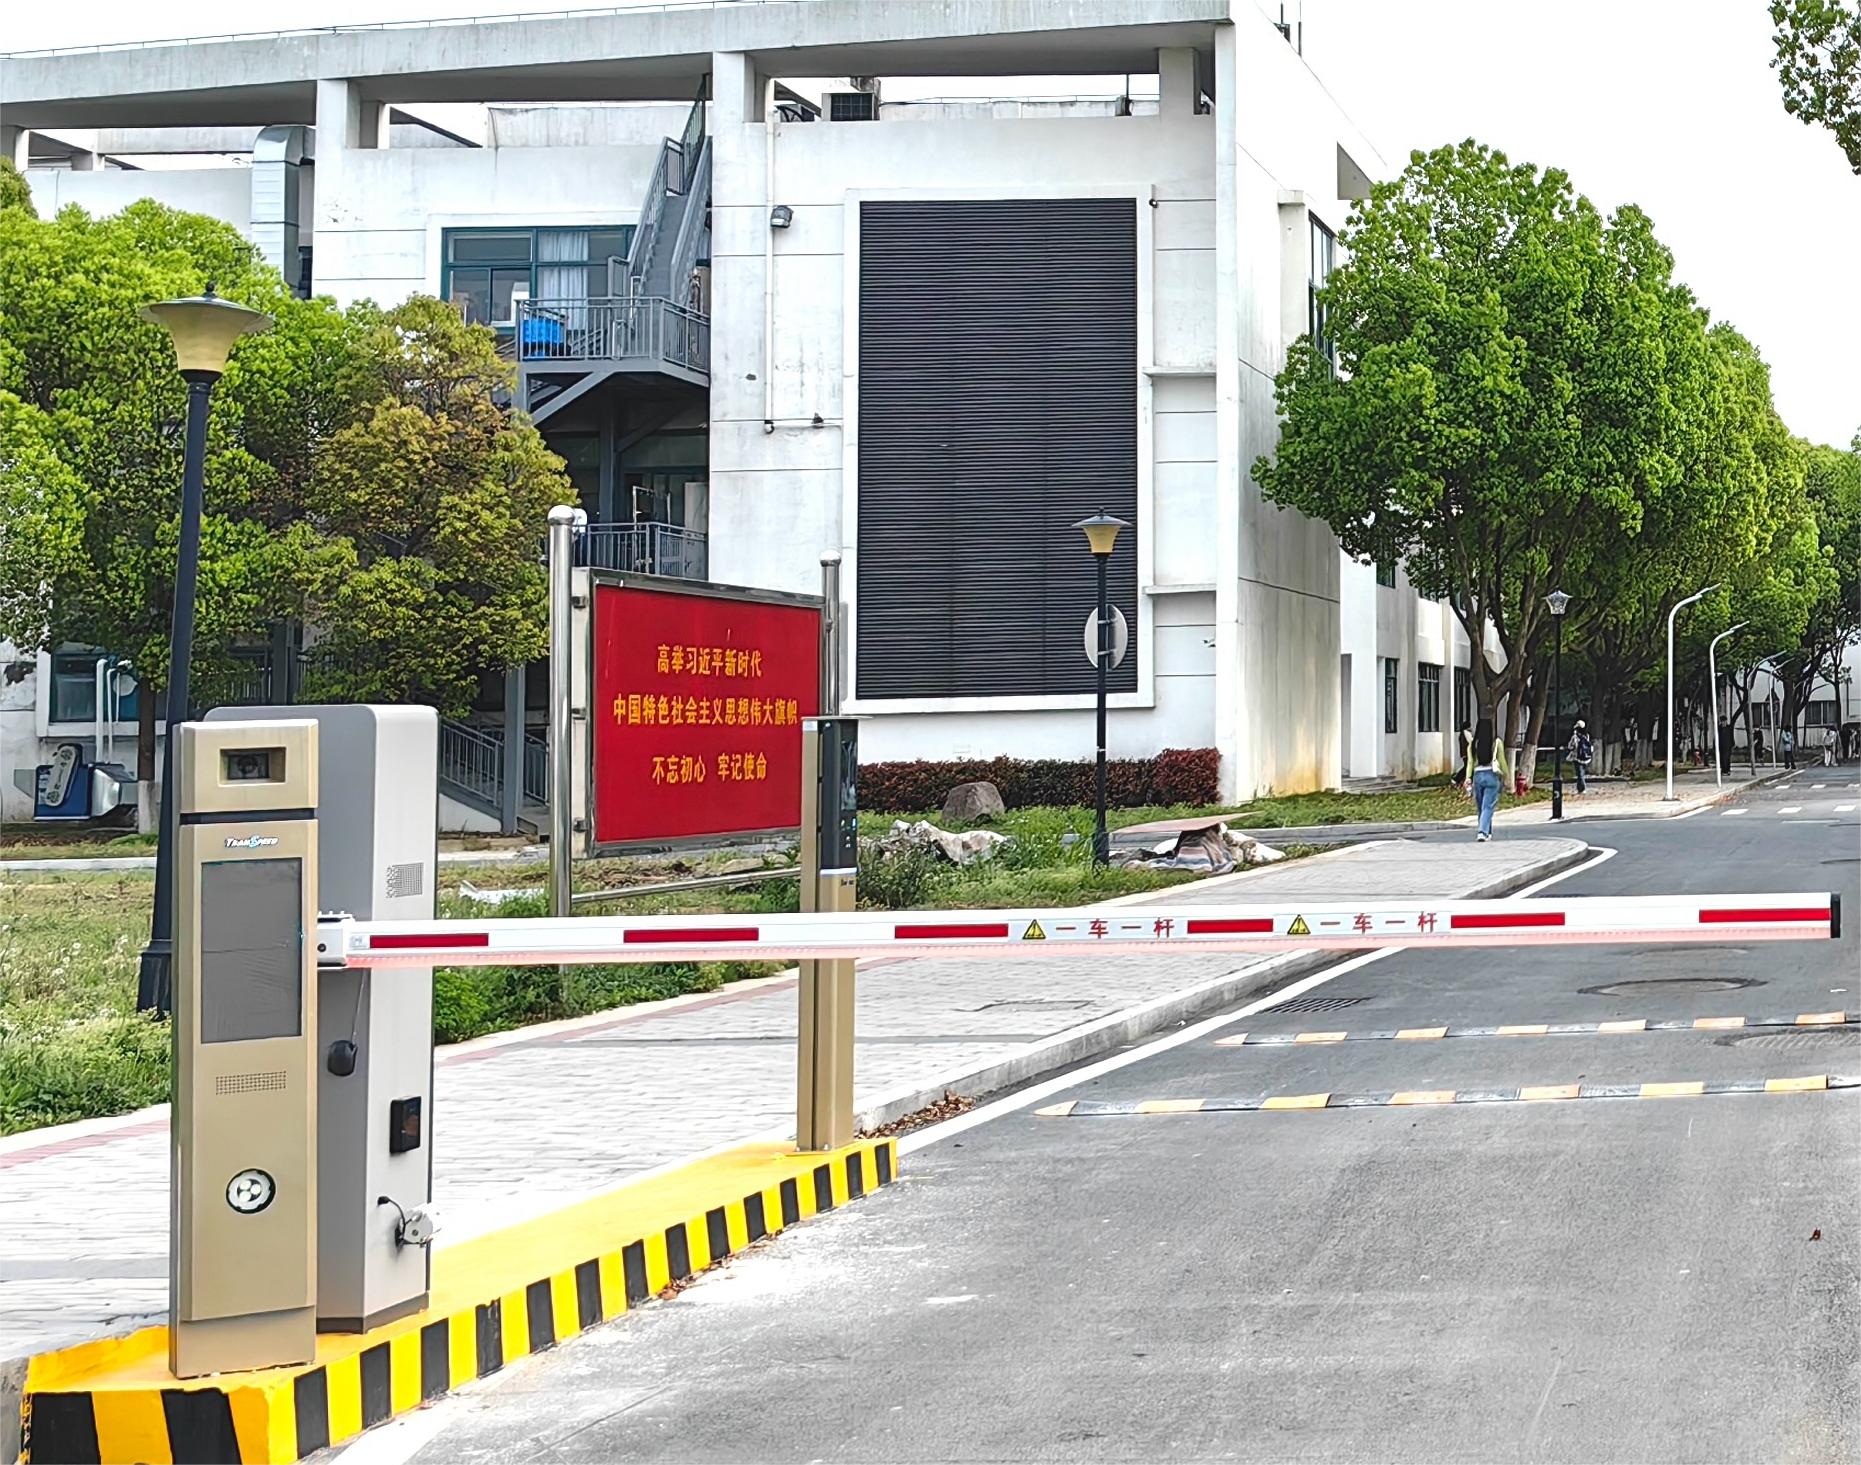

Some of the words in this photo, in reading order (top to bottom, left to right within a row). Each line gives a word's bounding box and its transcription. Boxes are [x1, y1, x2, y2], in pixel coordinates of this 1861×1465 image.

[657, 643, 762, 678] 高举习近平新时代
[613, 693, 798, 726] 中国特色社会主义思想伟大旗帜
[652, 754, 706, 785] 不忘初心
[717, 751, 768, 781] 牢记使命
[1055, 917, 1175, 939] 一车一杆
[1320, 911, 1438, 934] 一车一杆
